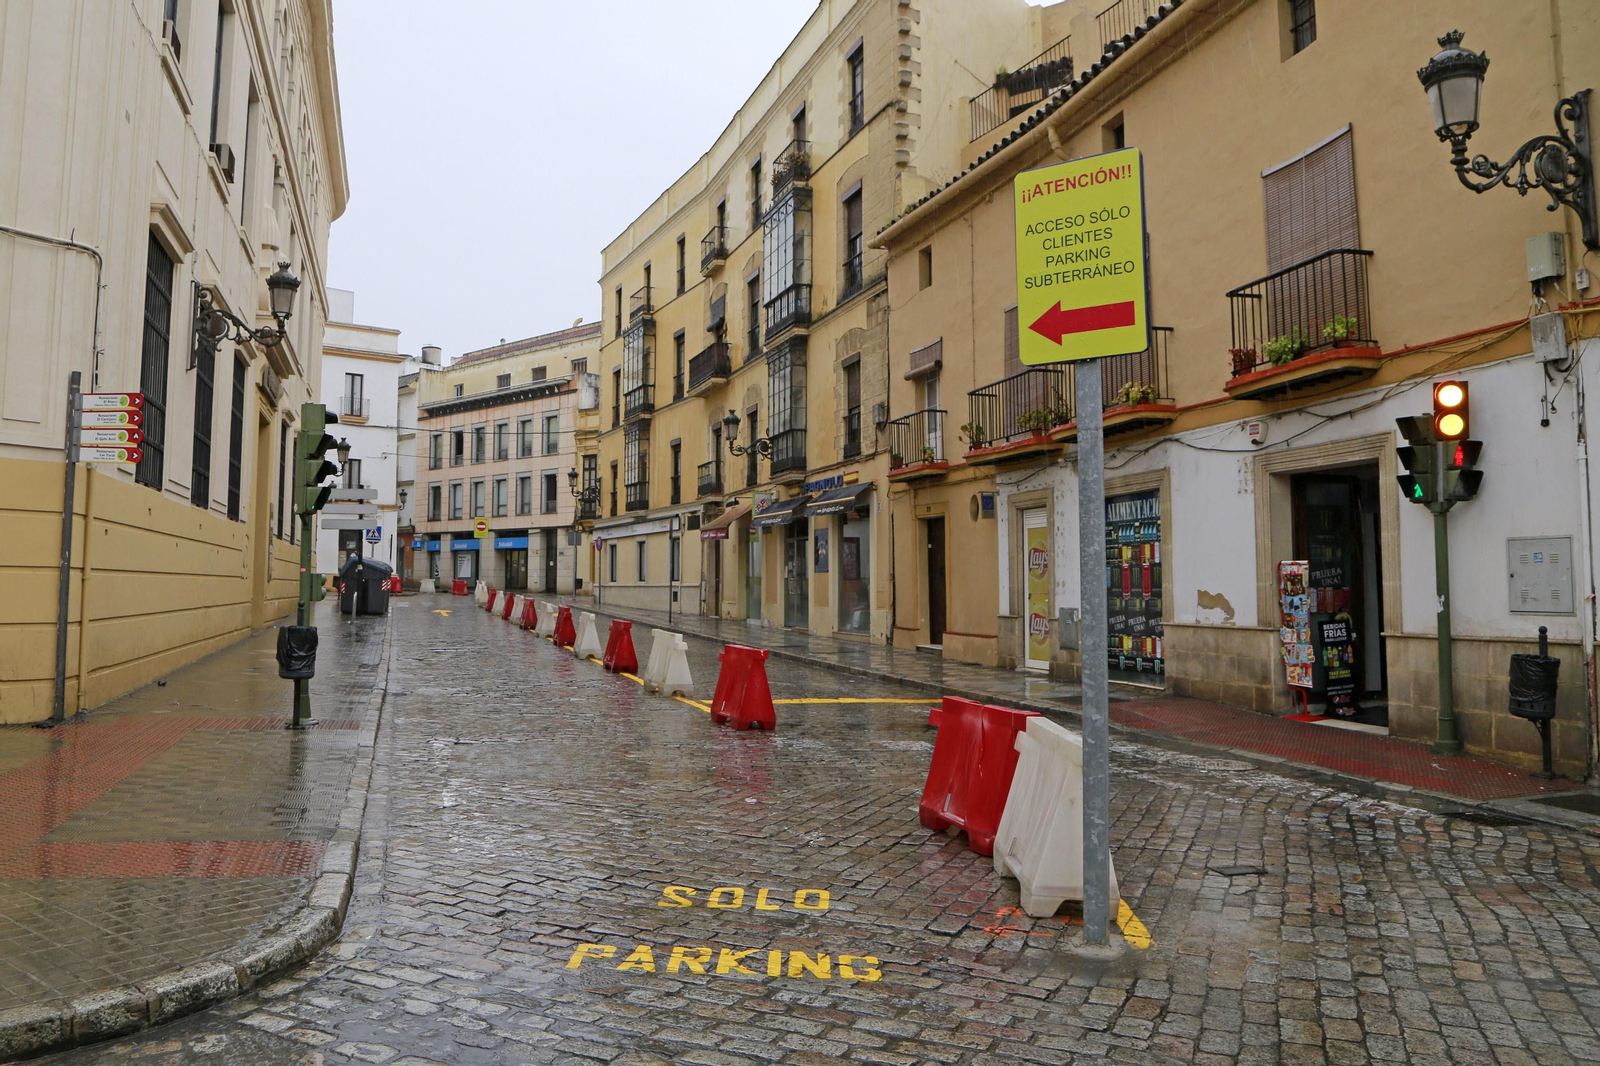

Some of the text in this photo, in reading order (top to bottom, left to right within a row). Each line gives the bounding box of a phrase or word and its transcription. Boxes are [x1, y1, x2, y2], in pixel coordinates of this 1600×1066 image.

[1022, 164, 1132, 203] ¡¡ATENCIÓN!!
[1025, 205, 1130, 236] ACCESO SÓLO
[1042, 227, 1113, 250] CLIENTES
[1045, 246, 1110, 268] PARKING
[1024, 260, 1135, 289] SUBTERRÁNEO
[1311, 567, 1342, 580] PRUEBA
[1322, 577, 1341, 587] UNA!
[657, 885, 830, 910] SOLO
[565, 943, 882, 982] PARKING
